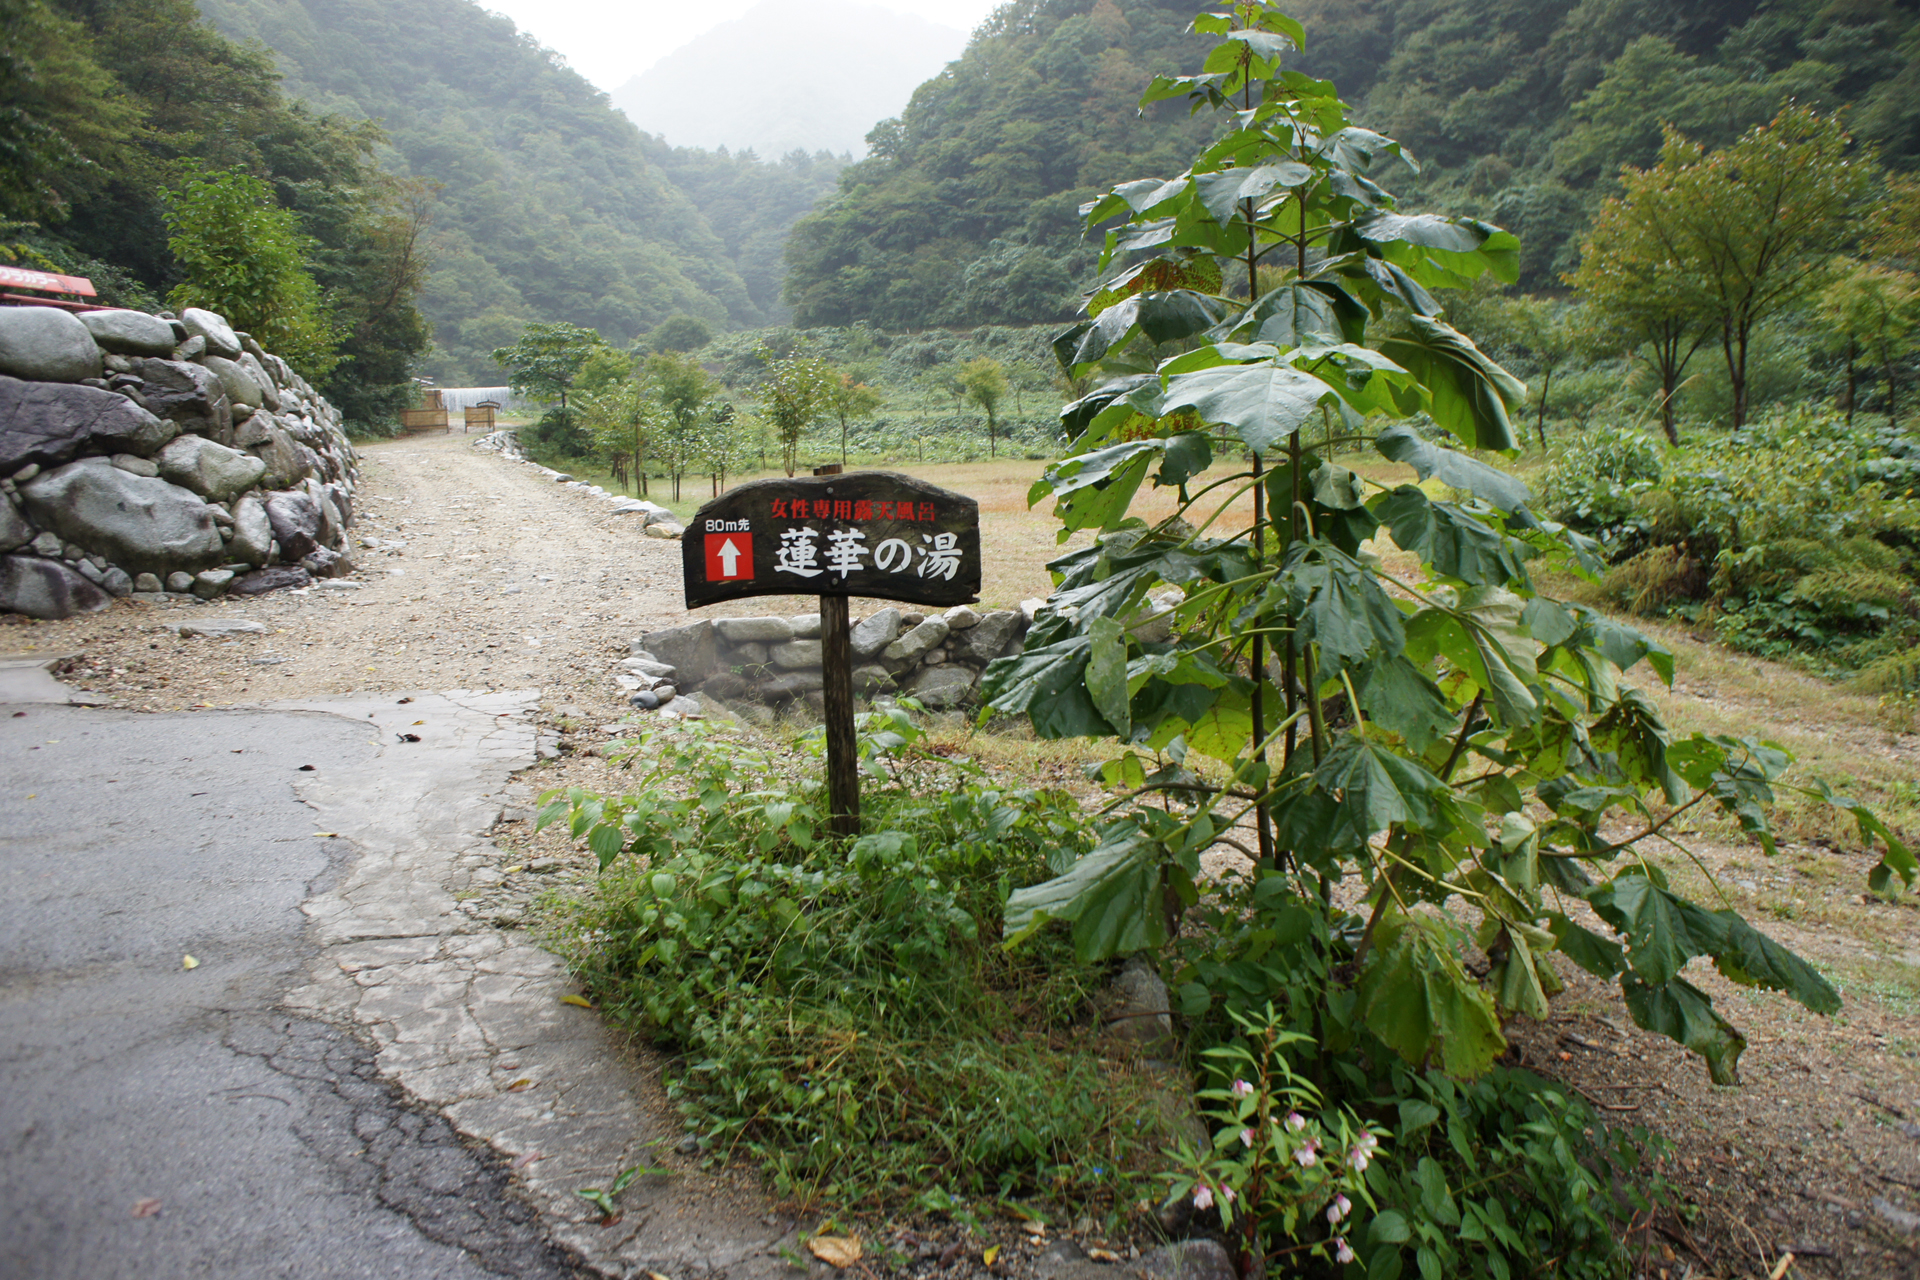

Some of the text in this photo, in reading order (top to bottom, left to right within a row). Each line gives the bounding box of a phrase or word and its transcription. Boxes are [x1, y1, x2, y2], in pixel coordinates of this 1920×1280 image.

[770, 498, 936, 522] 女性専用露天風呂
[705, 518, 750, 533] 80m先
[773, 526, 964, 581] 蓮華の湯
